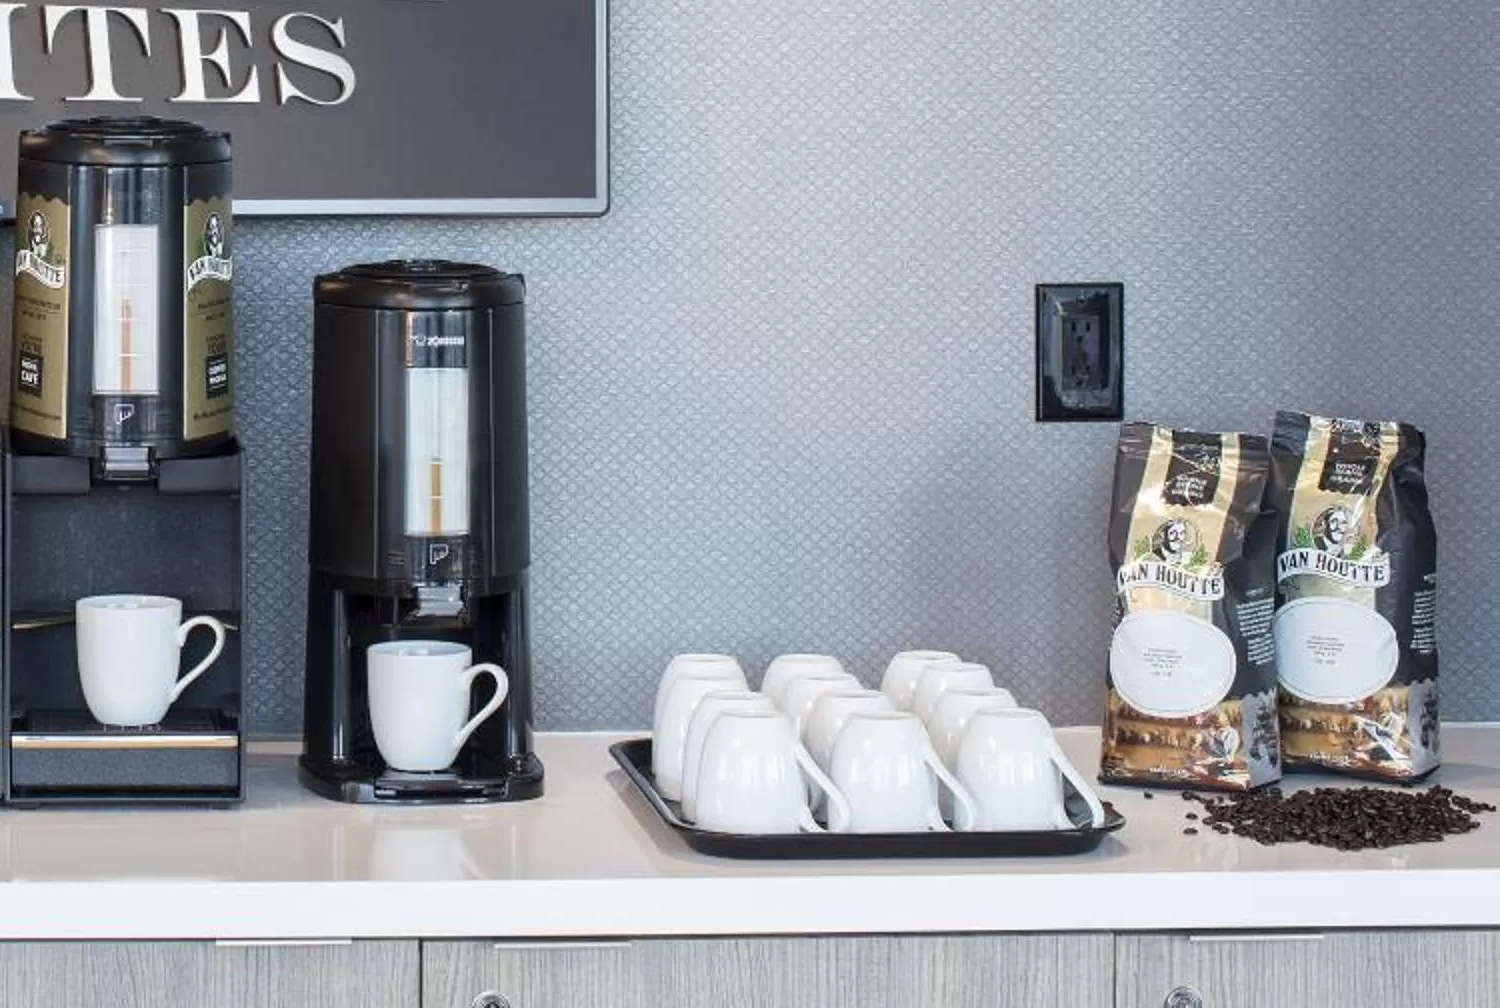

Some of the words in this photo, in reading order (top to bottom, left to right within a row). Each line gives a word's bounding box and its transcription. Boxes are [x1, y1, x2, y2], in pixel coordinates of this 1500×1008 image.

[1119, 563, 1149, 585] VAN
[1155, 565, 1222, 596] HOUTTE
[1279, 551, 1309, 574] VAN
[1315, 552, 1385, 583] HOUTTE
